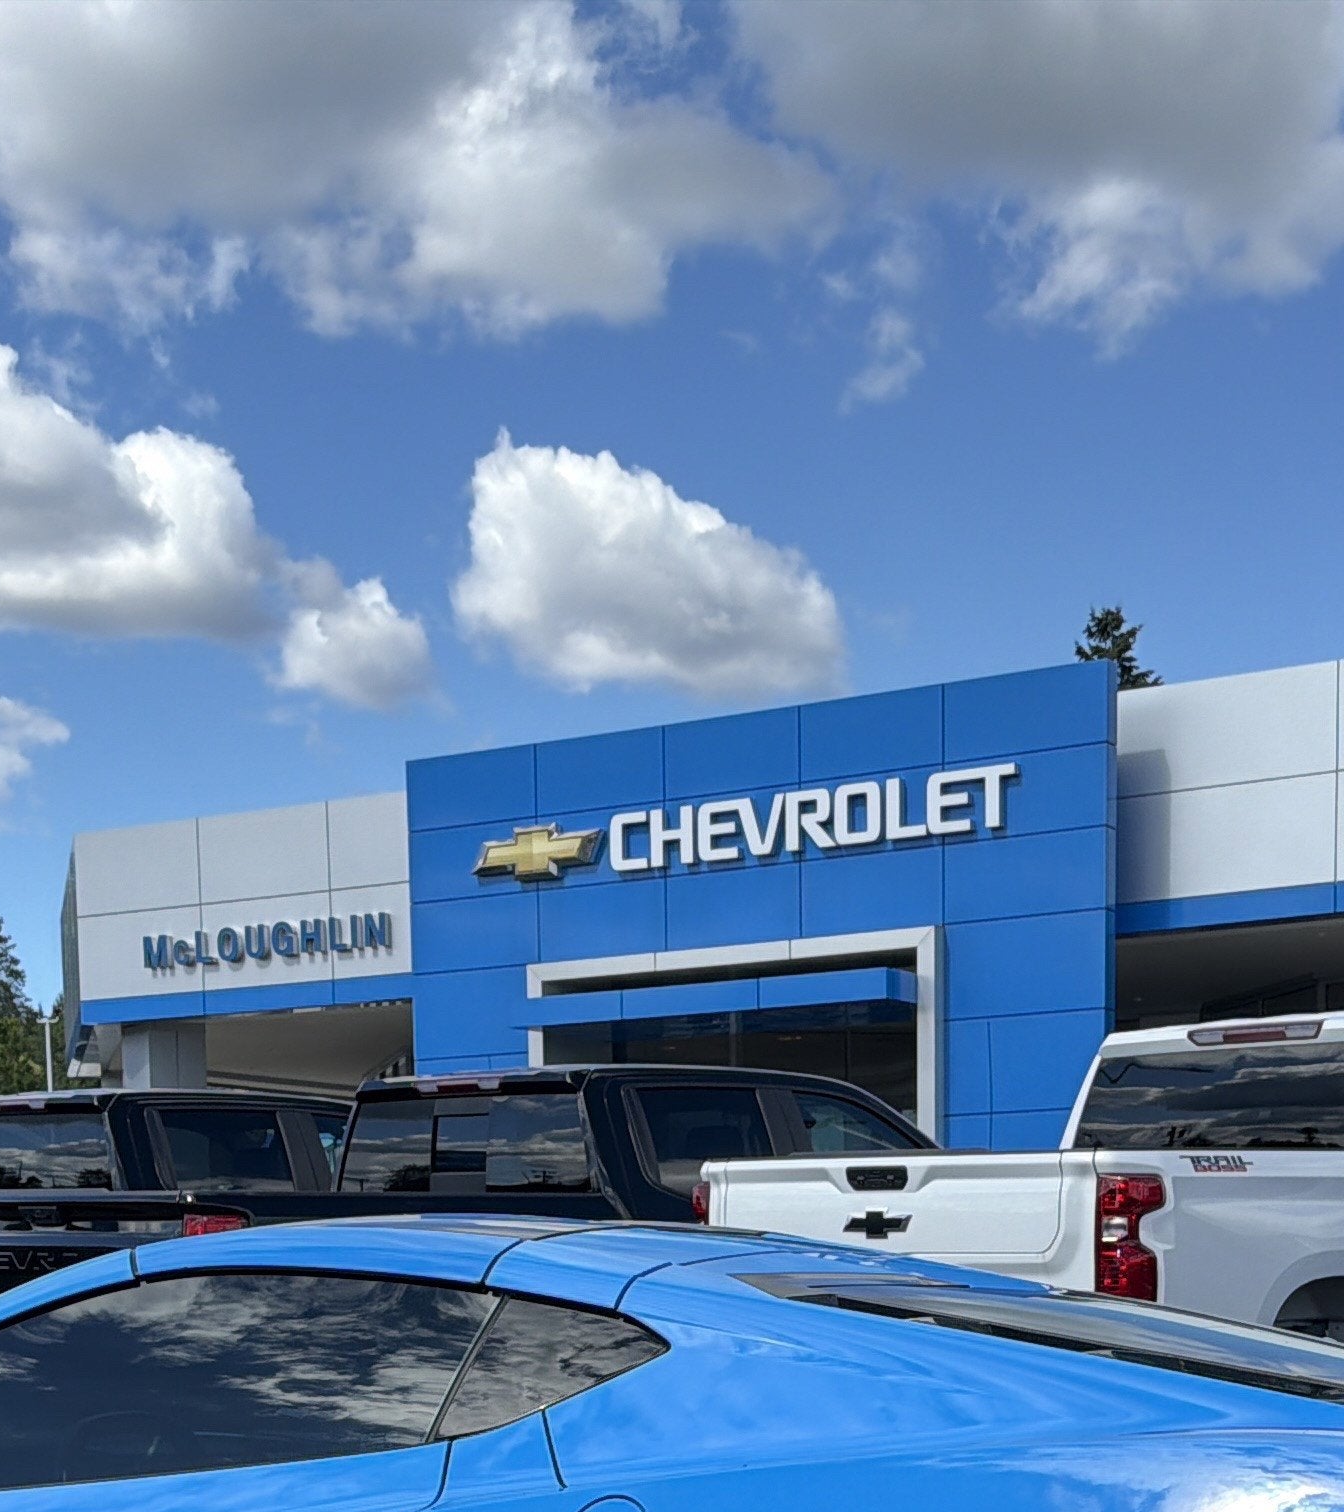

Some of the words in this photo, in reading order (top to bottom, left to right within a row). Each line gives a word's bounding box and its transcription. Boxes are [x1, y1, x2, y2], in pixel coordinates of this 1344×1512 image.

[609, 762, 1020, 872] CHEVROLET
[142, 911, 394, 971] McLOUGHLIN
[1179, 1155, 1254, 1167] TRAIL
